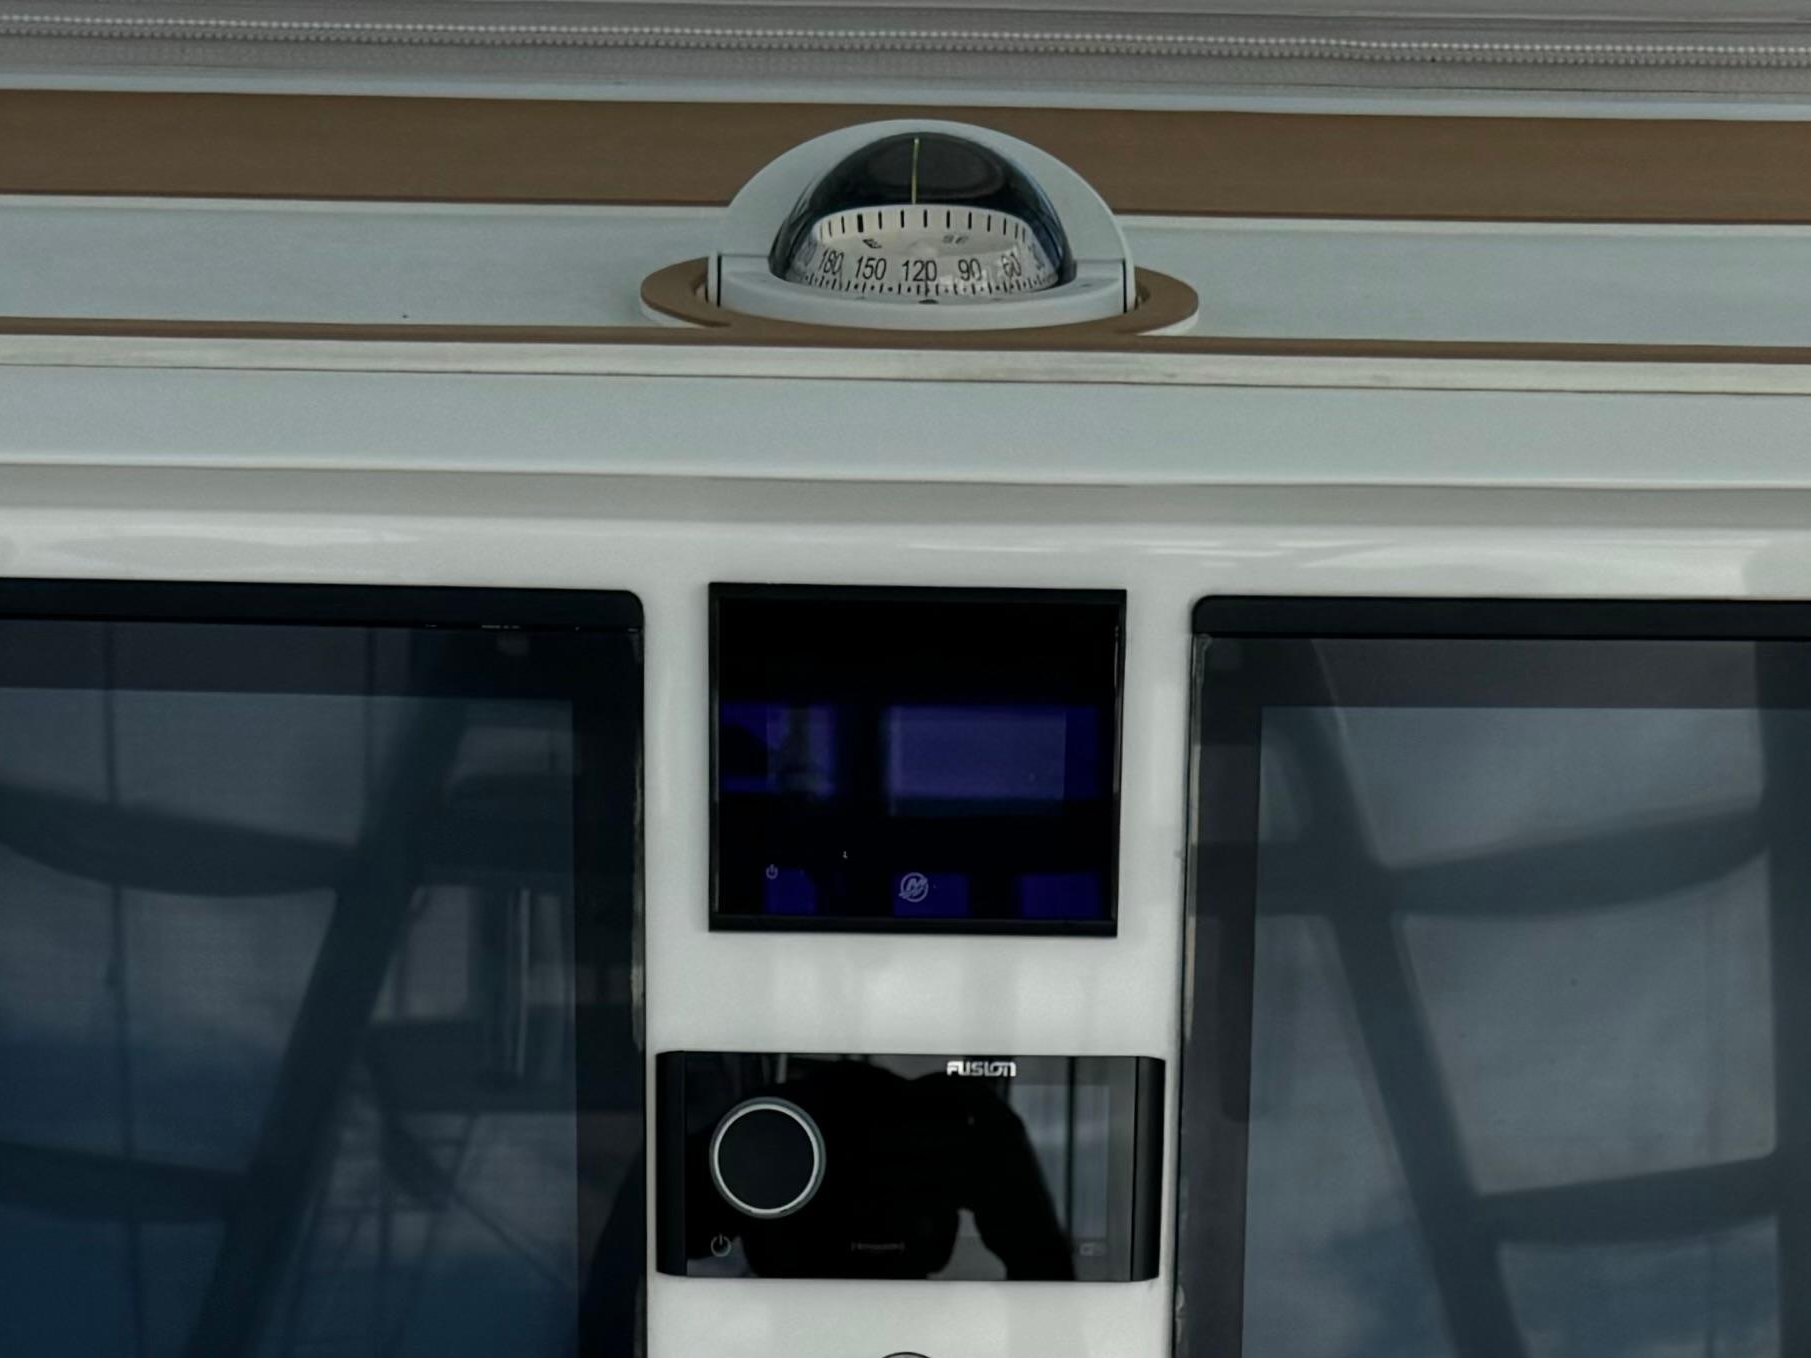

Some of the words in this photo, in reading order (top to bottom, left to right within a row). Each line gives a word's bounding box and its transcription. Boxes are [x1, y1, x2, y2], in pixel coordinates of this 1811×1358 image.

[819, 249, 845, 276] 180
[855, 258, 887, 281] 150
[901, 260, 937, 282] 120
[958, 258, 982, 281] 90
